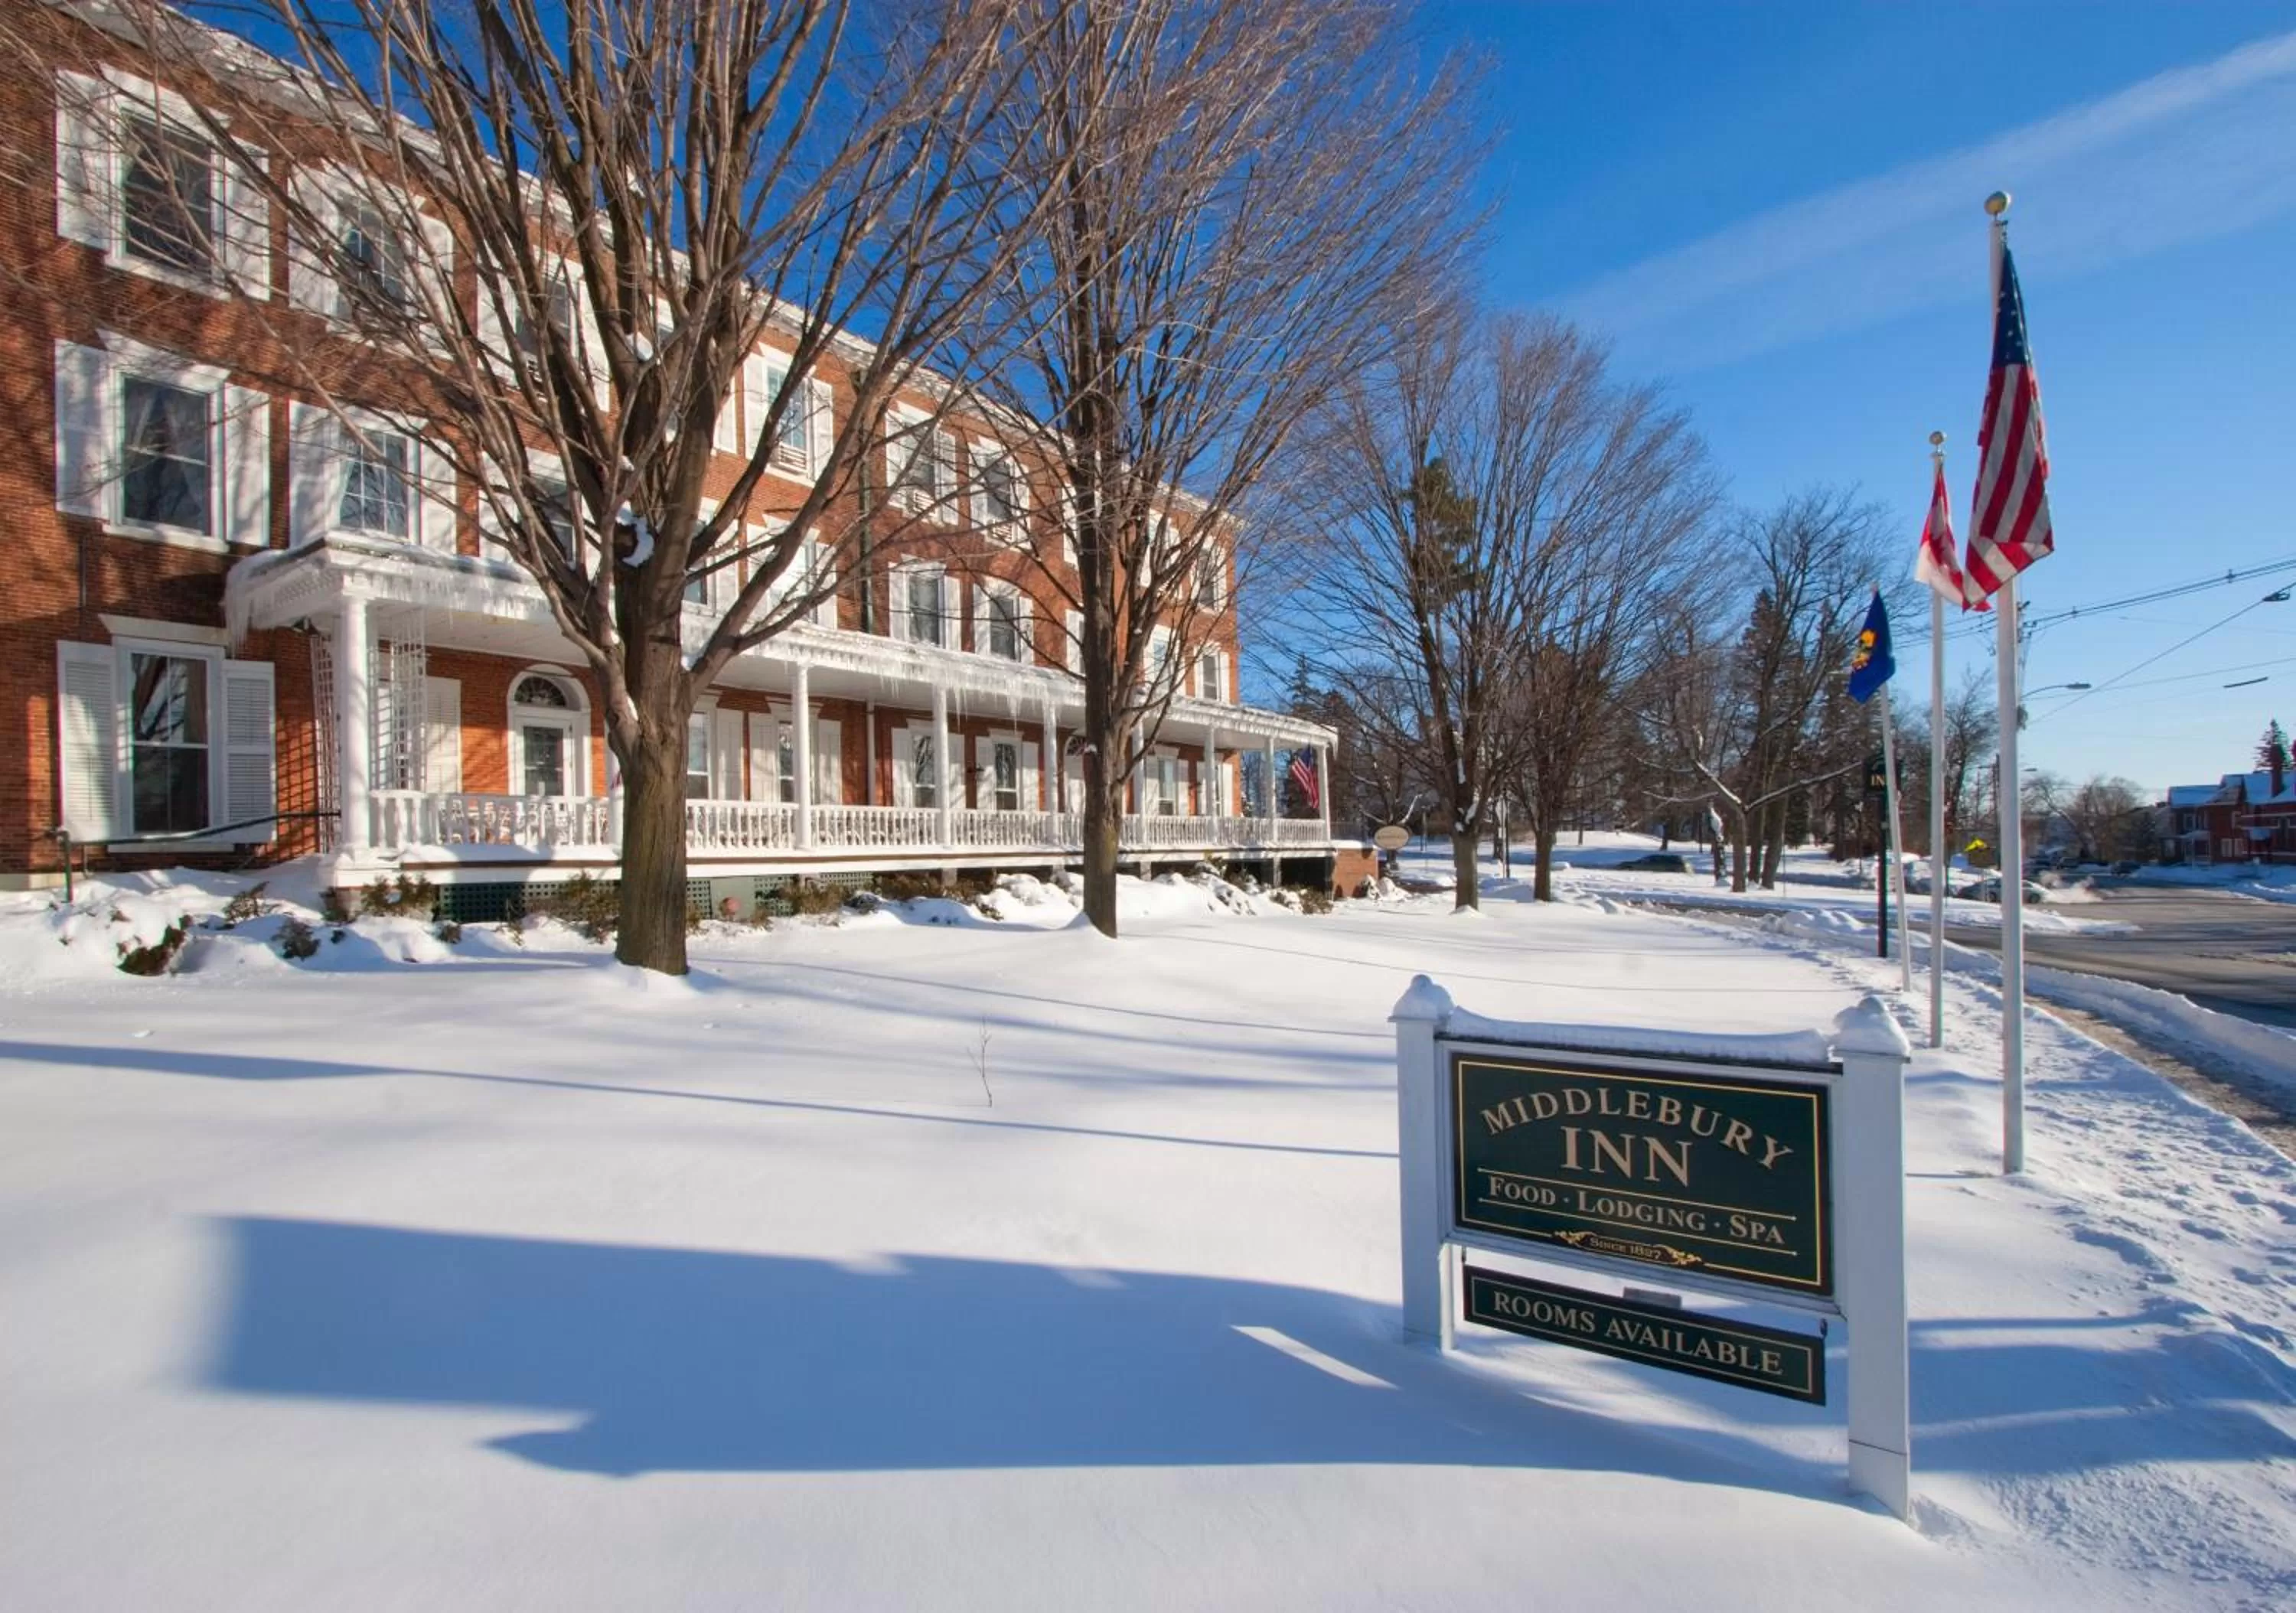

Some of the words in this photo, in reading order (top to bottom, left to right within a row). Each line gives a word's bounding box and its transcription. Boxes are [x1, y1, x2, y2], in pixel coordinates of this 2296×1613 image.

[1480, 1087, 1793, 1170] MIDDLEBURY
[1560, 1126, 1693, 1187] INN
[1488, 1175, 1556, 1206] FOOD
[1577, 1189, 1707, 1231] LODGING
[1730, 1214, 1786, 1244] SPA
[1493, 1291, 1596, 1333] ROOMS
[1604, 1316, 1784, 1375] AVAILABLE
